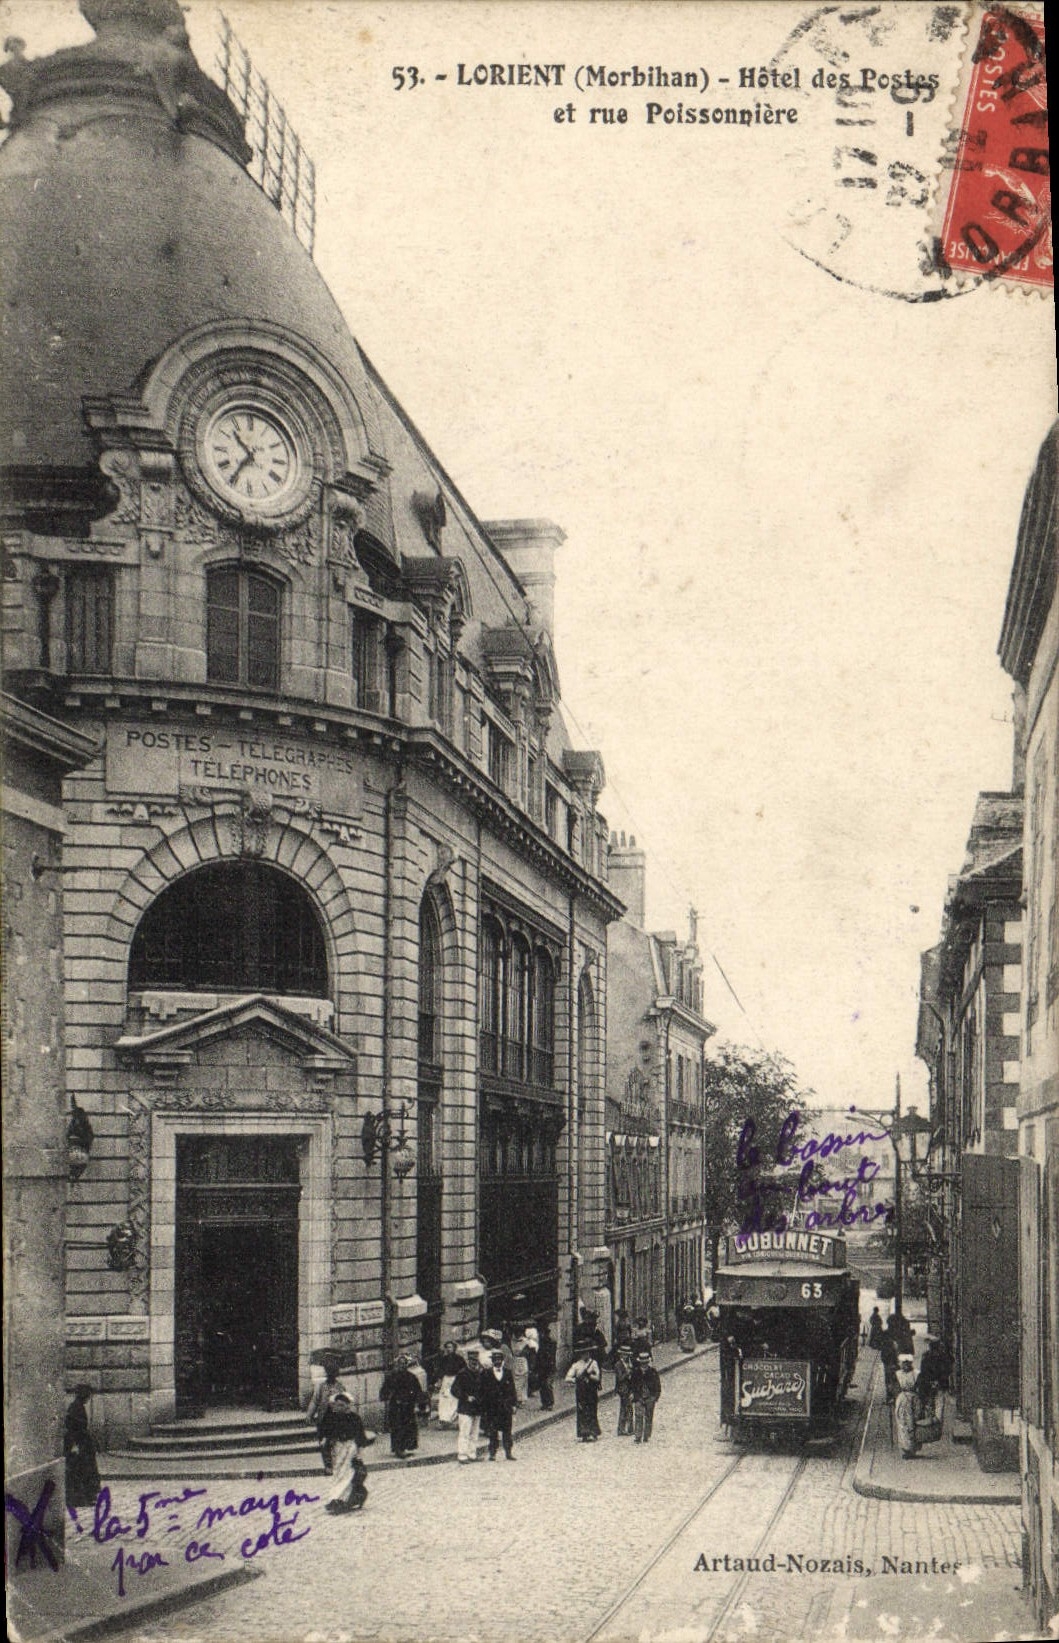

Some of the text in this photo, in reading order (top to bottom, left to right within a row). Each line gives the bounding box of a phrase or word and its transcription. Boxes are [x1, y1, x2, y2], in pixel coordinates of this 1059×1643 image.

[976, 25, 1010, 112] OSTES
[125, 731, 212, 752] POSTES
[734, 1231, 832, 1256] DUBONNET
[801, 1282, 823, 1299] 63
[741, 1373, 805, 1408] Suchard
